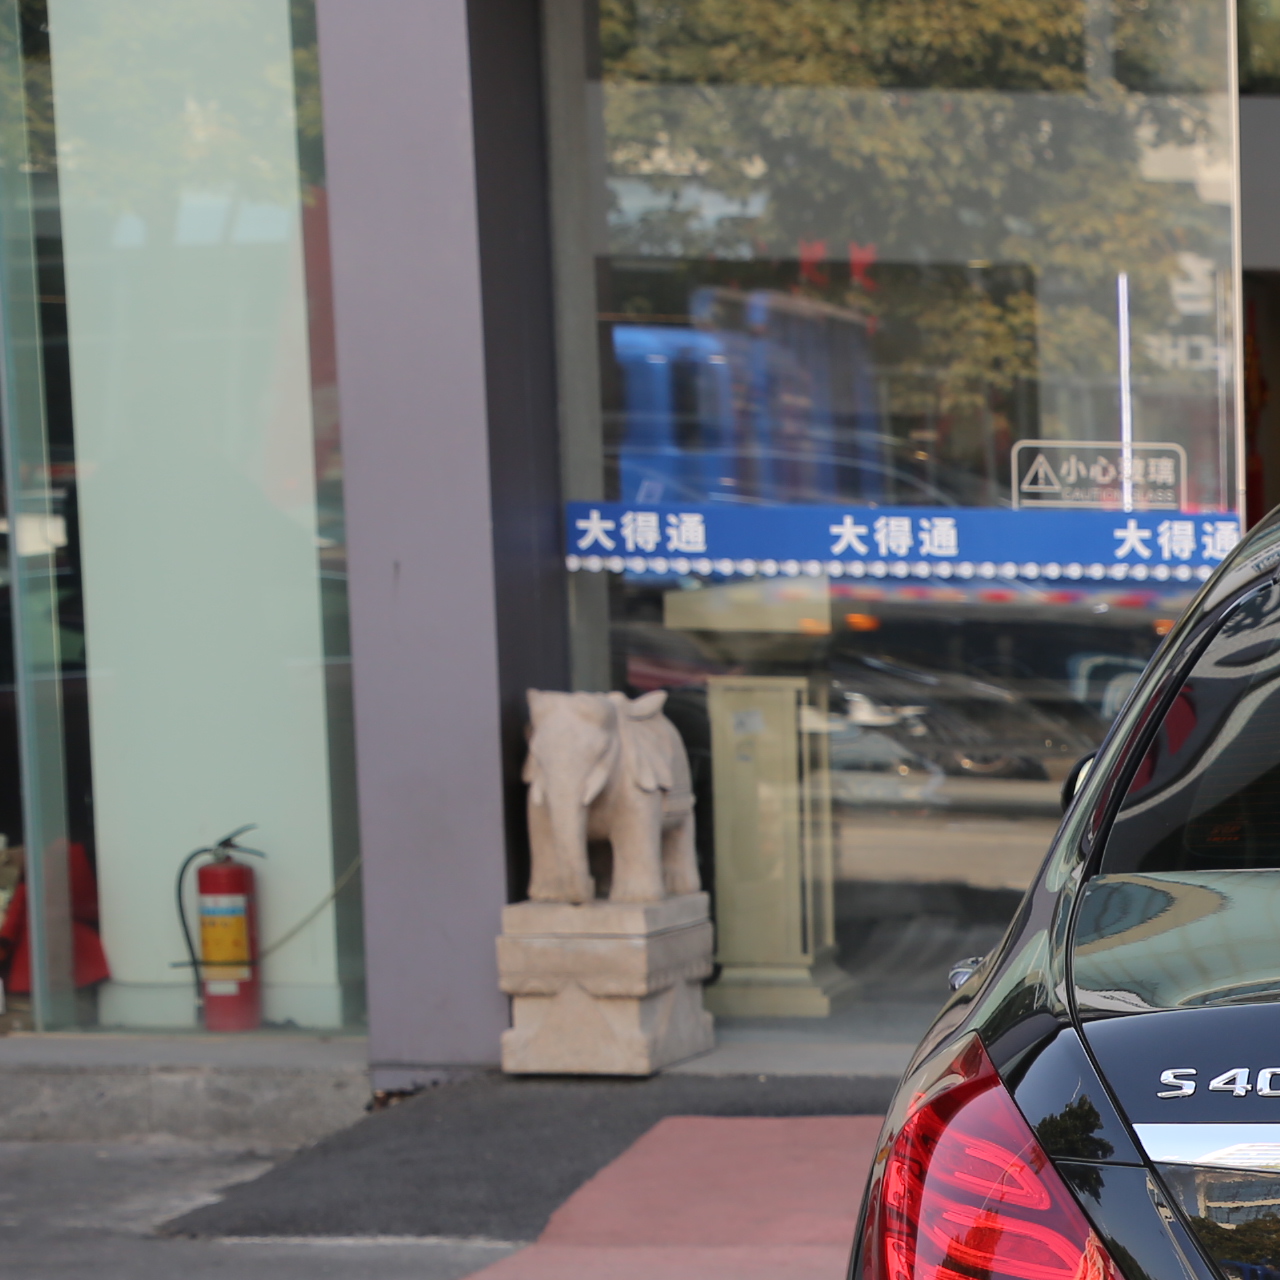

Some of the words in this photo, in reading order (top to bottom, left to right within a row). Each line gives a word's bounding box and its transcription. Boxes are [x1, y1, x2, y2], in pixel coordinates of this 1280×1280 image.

[575, 509, 707, 553] 大得通
[829, 514, 959, 557] 大得通
[1113, 518, 1240, 561] 大得通
